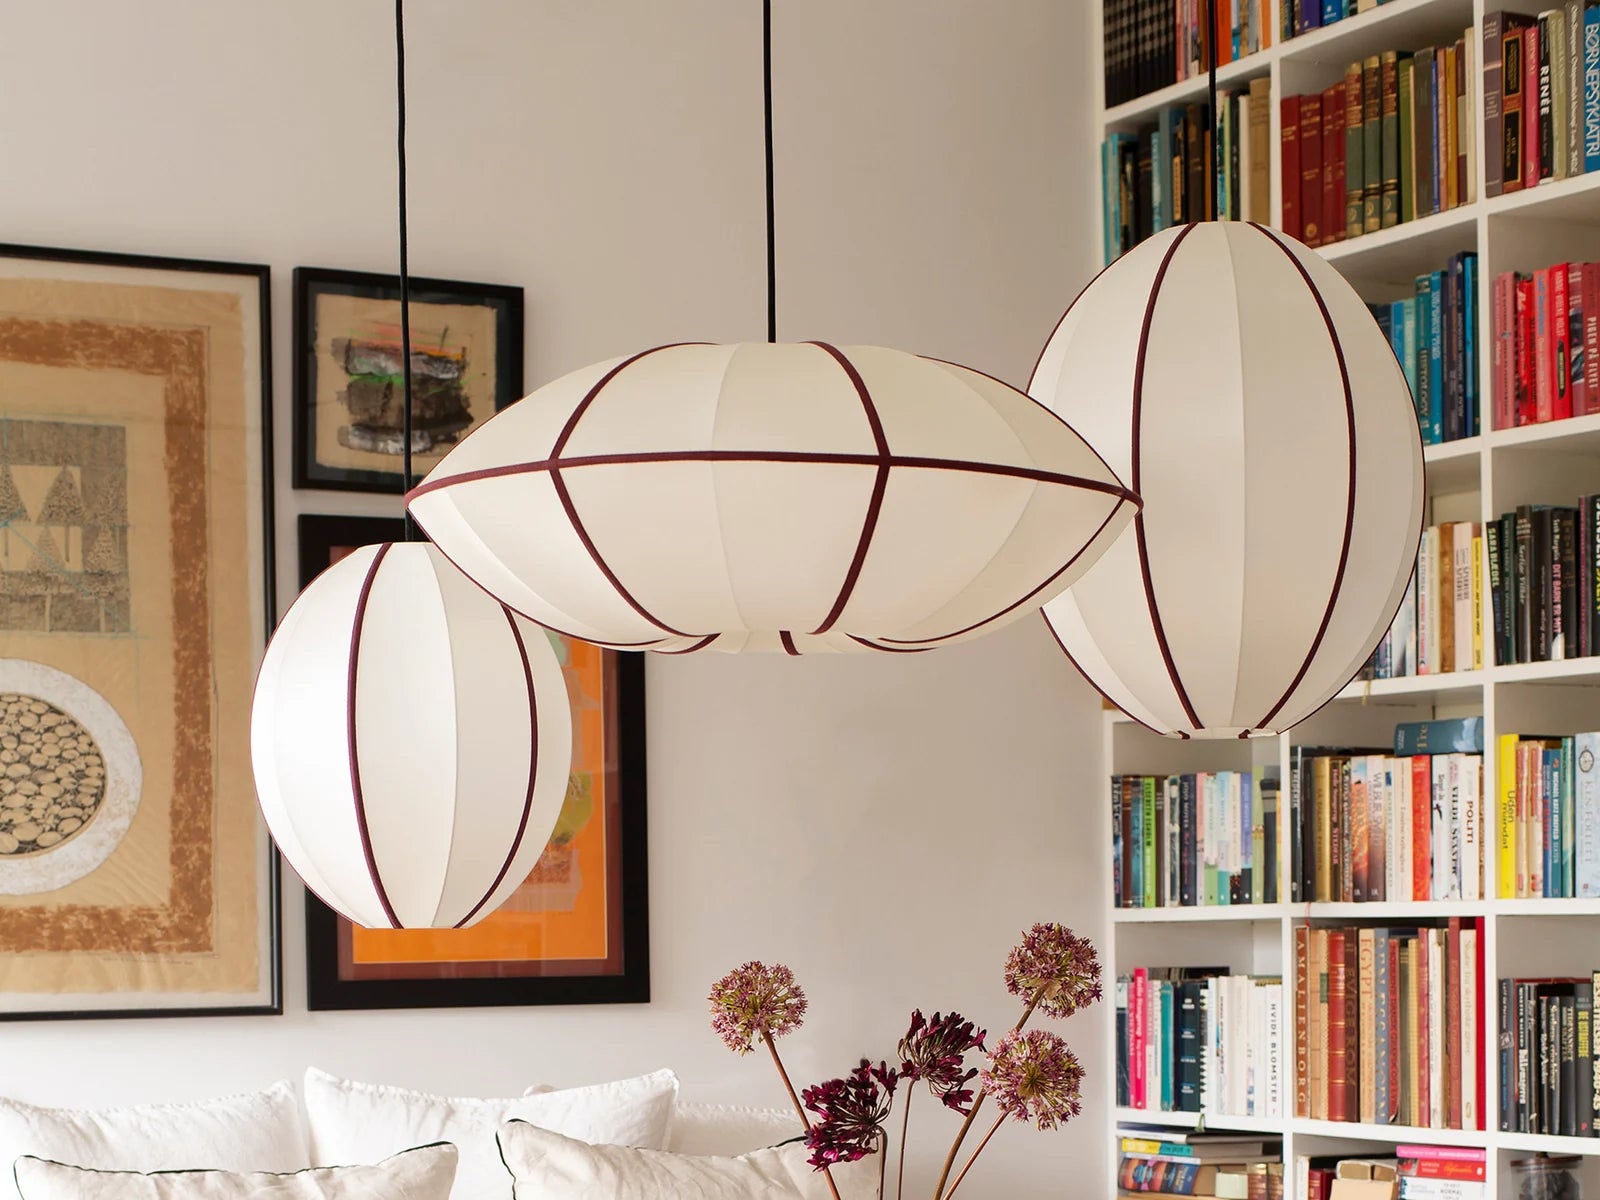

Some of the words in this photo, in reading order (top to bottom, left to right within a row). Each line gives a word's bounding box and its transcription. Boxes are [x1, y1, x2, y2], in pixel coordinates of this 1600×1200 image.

[1586, 24, 1600, 157] BØRNEPSYKIATRI
[1587, 317, 1598, 346] PIGEN
[1552, 563, 1562, 578] DIT
[1553, 580, 1562, 602] BARN
[1507, 790, 1515, 823] Uden
[1584, 780, 1592, 808] KEN
[1466, 801, 1474, 844] POLITI
[1360, 938, 1374, 1000] EGYPT
[1297, 940, 1306, 1103] AMALIENBORG
